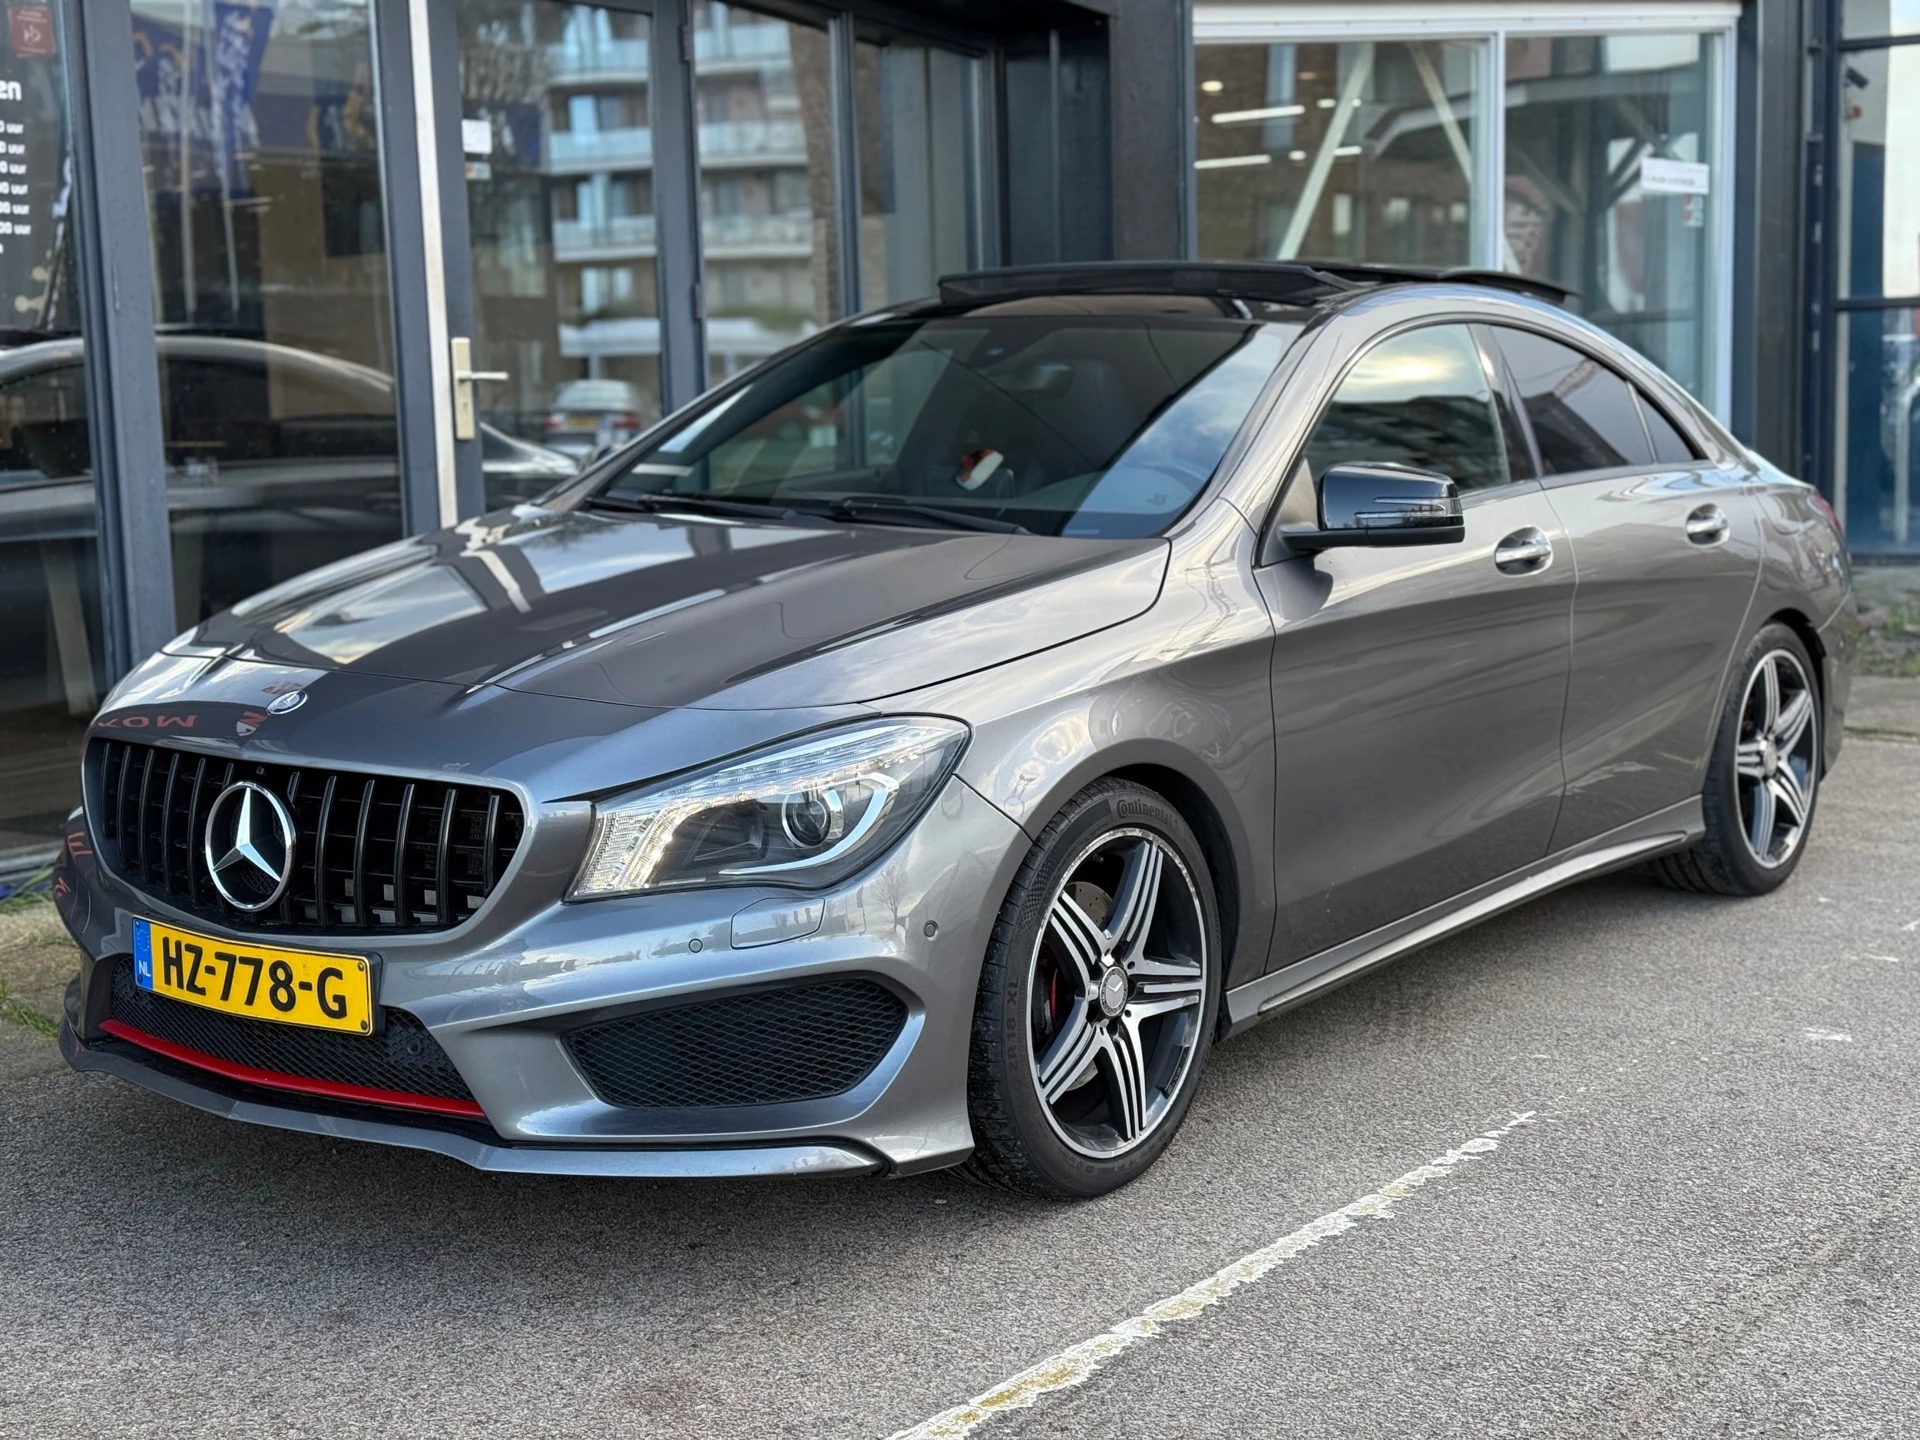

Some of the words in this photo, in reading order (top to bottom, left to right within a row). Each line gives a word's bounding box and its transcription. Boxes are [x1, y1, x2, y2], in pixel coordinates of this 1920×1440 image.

[1117, 799, 1172, 828] Continental
[138, 960, 151, 977] NL
[162, 936, 348, 1019] HZ-778-G
